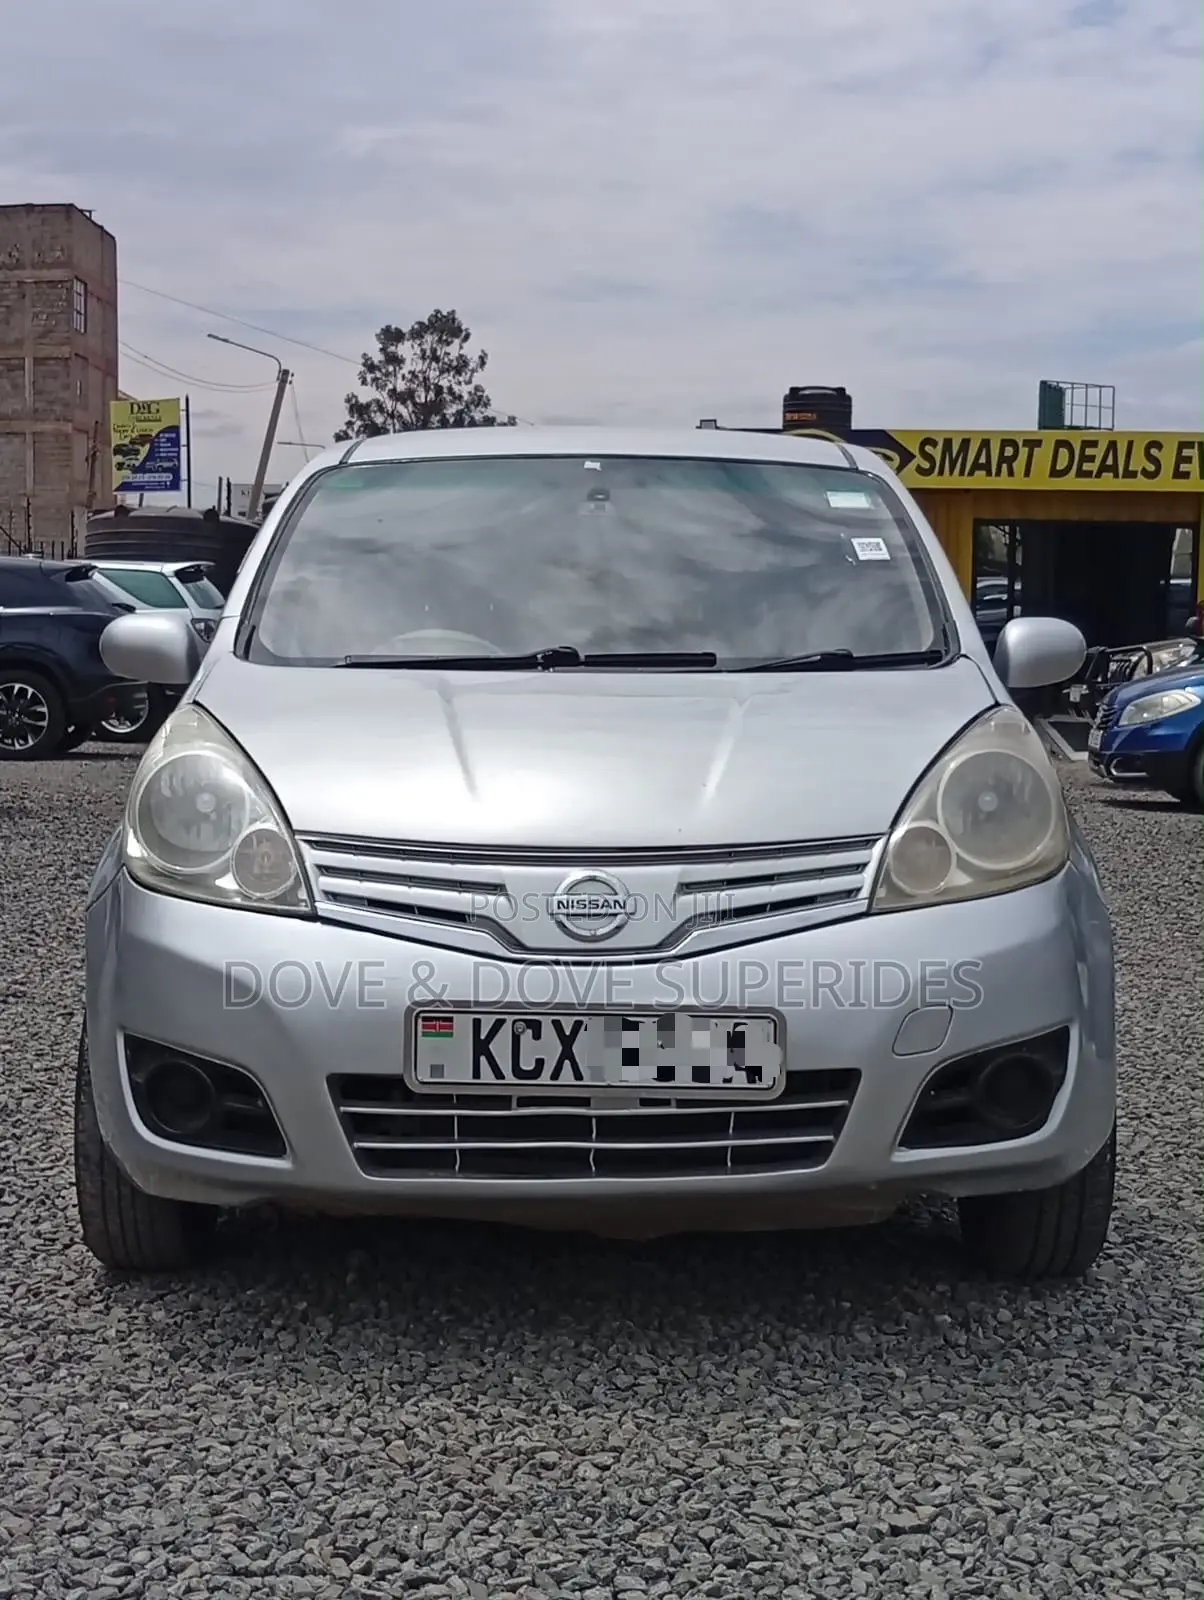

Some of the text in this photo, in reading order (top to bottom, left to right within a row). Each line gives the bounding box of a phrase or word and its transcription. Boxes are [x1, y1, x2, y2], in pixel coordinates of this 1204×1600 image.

[914, 437, 1204, 480] SMART DEALS E
[556, 898, 627, 910] NISSAN
[471, 1016, 585, 1081] KCX
